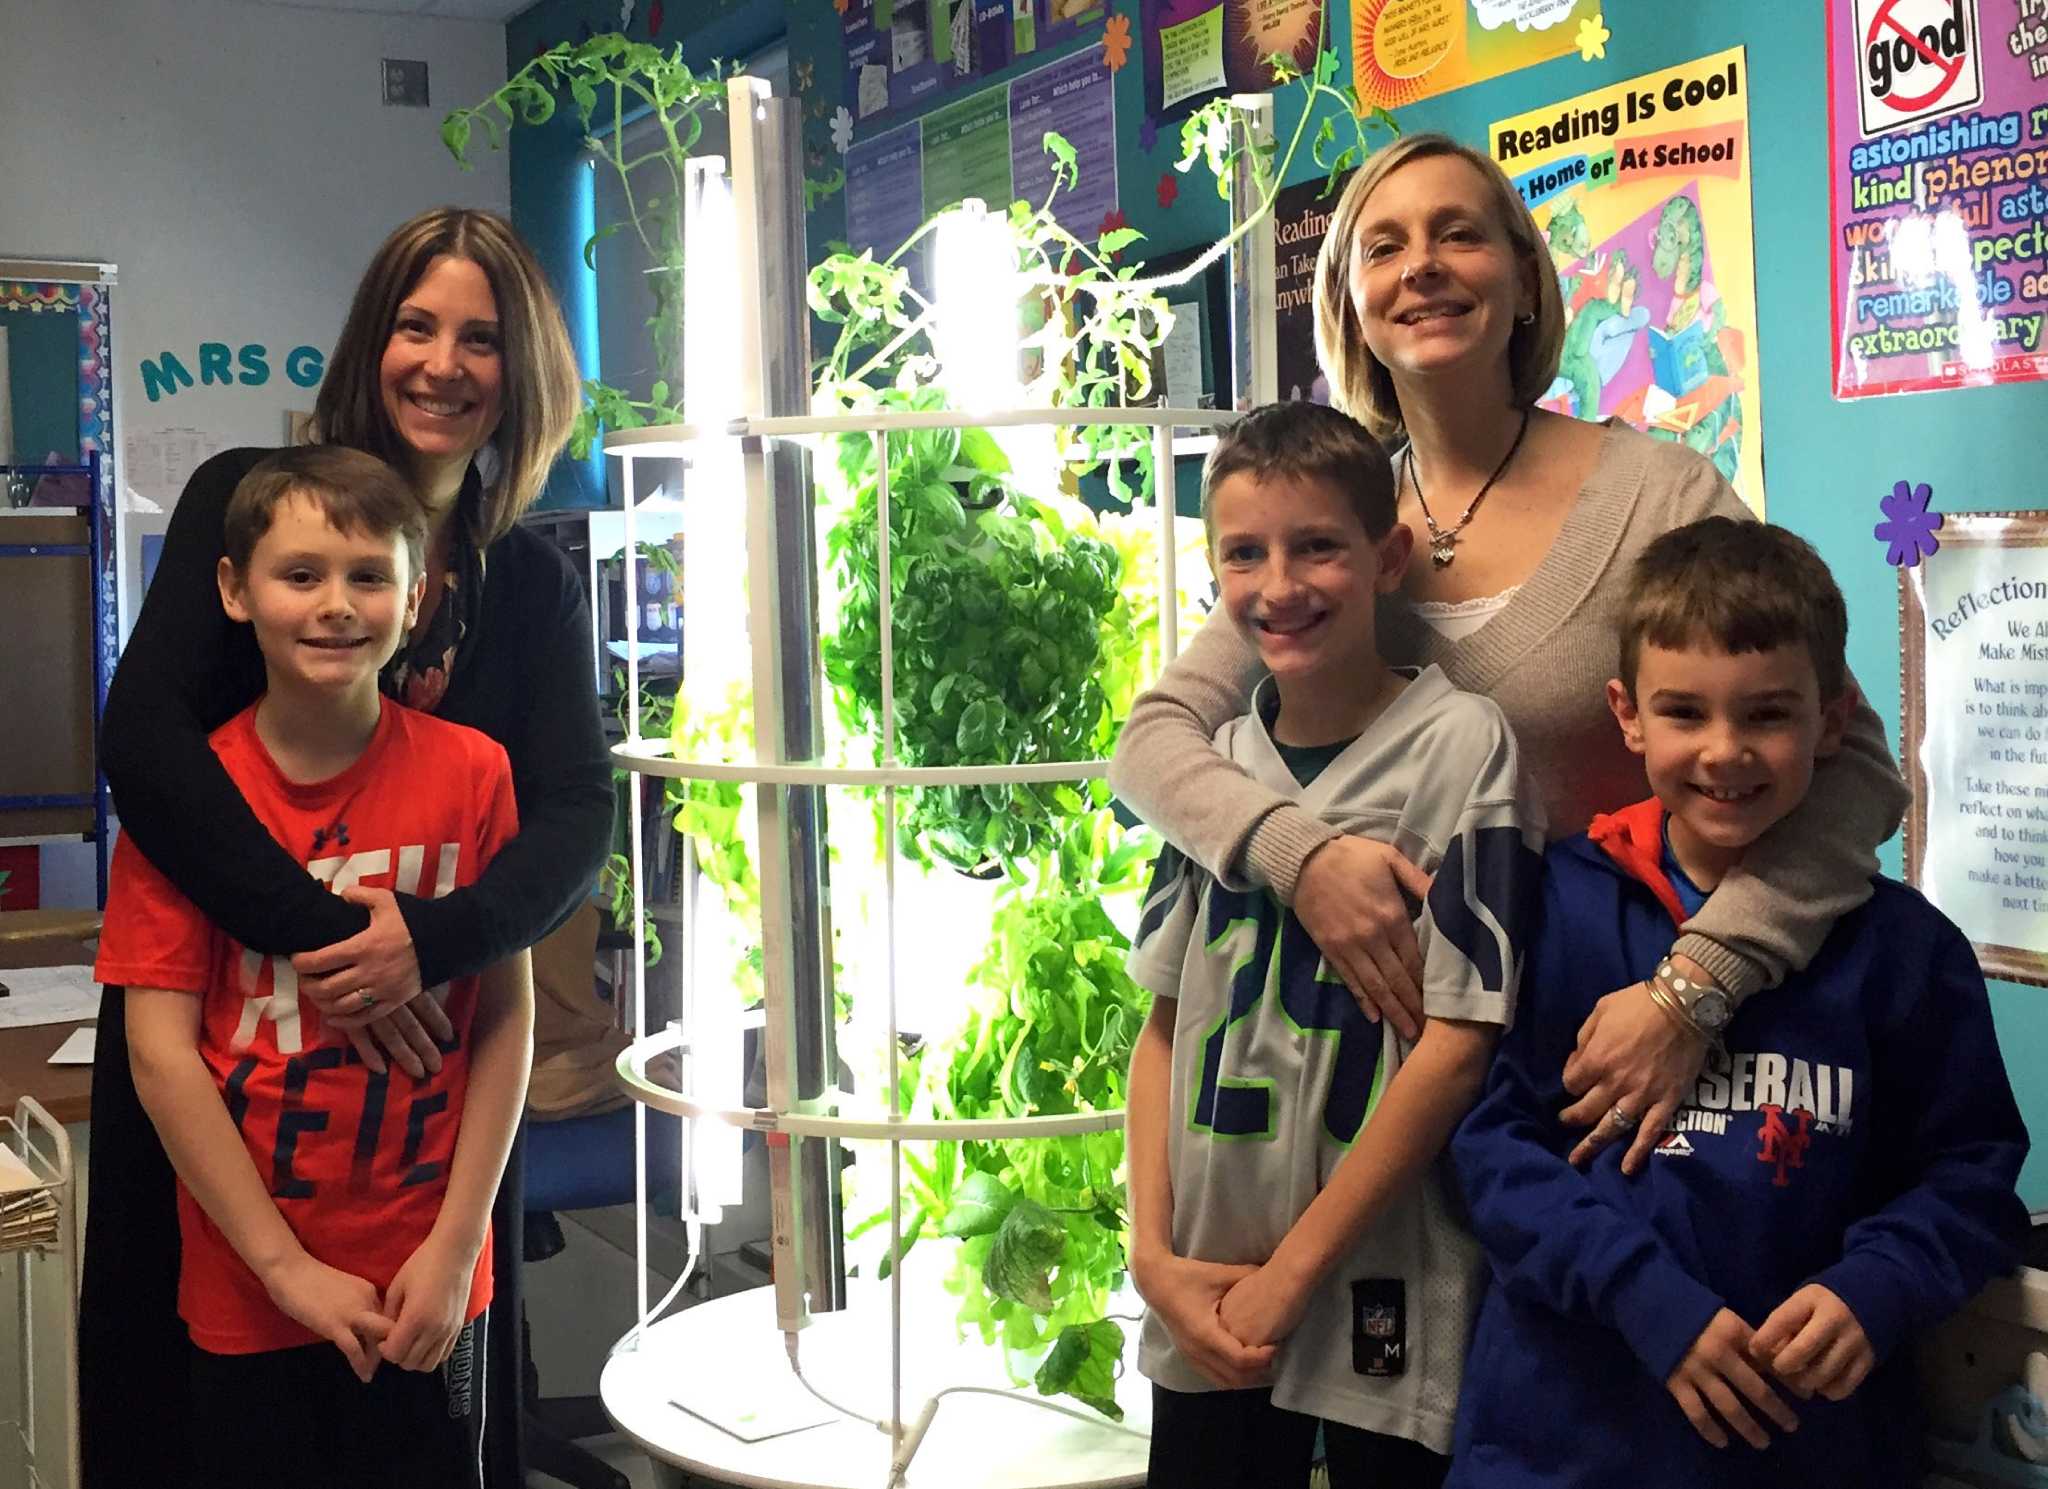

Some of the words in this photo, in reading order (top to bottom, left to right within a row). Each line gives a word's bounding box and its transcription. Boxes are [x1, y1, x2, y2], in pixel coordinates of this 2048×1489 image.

[2010, 22, 2048, 54] the
[1869, 0, 1966, 97] good
[1498, 102, 1619, 161] Reading
[1627, 91, 1656, 124] Is
[1663, 62, 1737, 112] Cool
[1852, 114, 2019, 171] astonishing
[1529, 158, 1586, 200] Home
[1591, 156, 1614, 180] or
[1619, 148, 1648, 171] At
[1653, 138, 1734, 168] School
[1855, 164, 1912, 208] kind
[1290, 253, 1316, 276] Take
[140, 342, 270, 402] MRS
[285, 345, 325, 387] G
[2008, 620, 2030, 638] We
[1979, 643, 2015, 660] Make
[1974, 678, 2005, 693] What
[2010, 680, 2020, 694] is
[1966, 701, 1975, 714] is
[1979, 702, 1992, 715] to
[1997, 702, 2028, 718] think
[1978, 727, 1995, 738] we
[2000, 728, 2020, 740] can
[2025, 726, 2041, 741] do
[1990, 749, 2000, 760] in
[2005, 748, 2026, 762] the
[1966, 777, 1992, 794] Take
[1996, 780, 2030, 797] these
[1960, 800, 2002, 818] reflect
[2007, 808, 2022, 819] on
[1976, 825, 1997, 839] and
[2002, 828, 2015, 841] to
[1995, 848, 2019, 863] how
[2024, 855, 2045, 868] you
[1968, 870, 1999, 885] make
[2003, 874, 2011, 886] a
[2003, 897, 2028, 911] next
[1686, 1053, 1853, 1126] SEBALL
[1668, 1110, 1727, 1136] CTION
[1367, 1318, 1393, 1336] NFL
[1385, 1343, 1400, 1358] M
